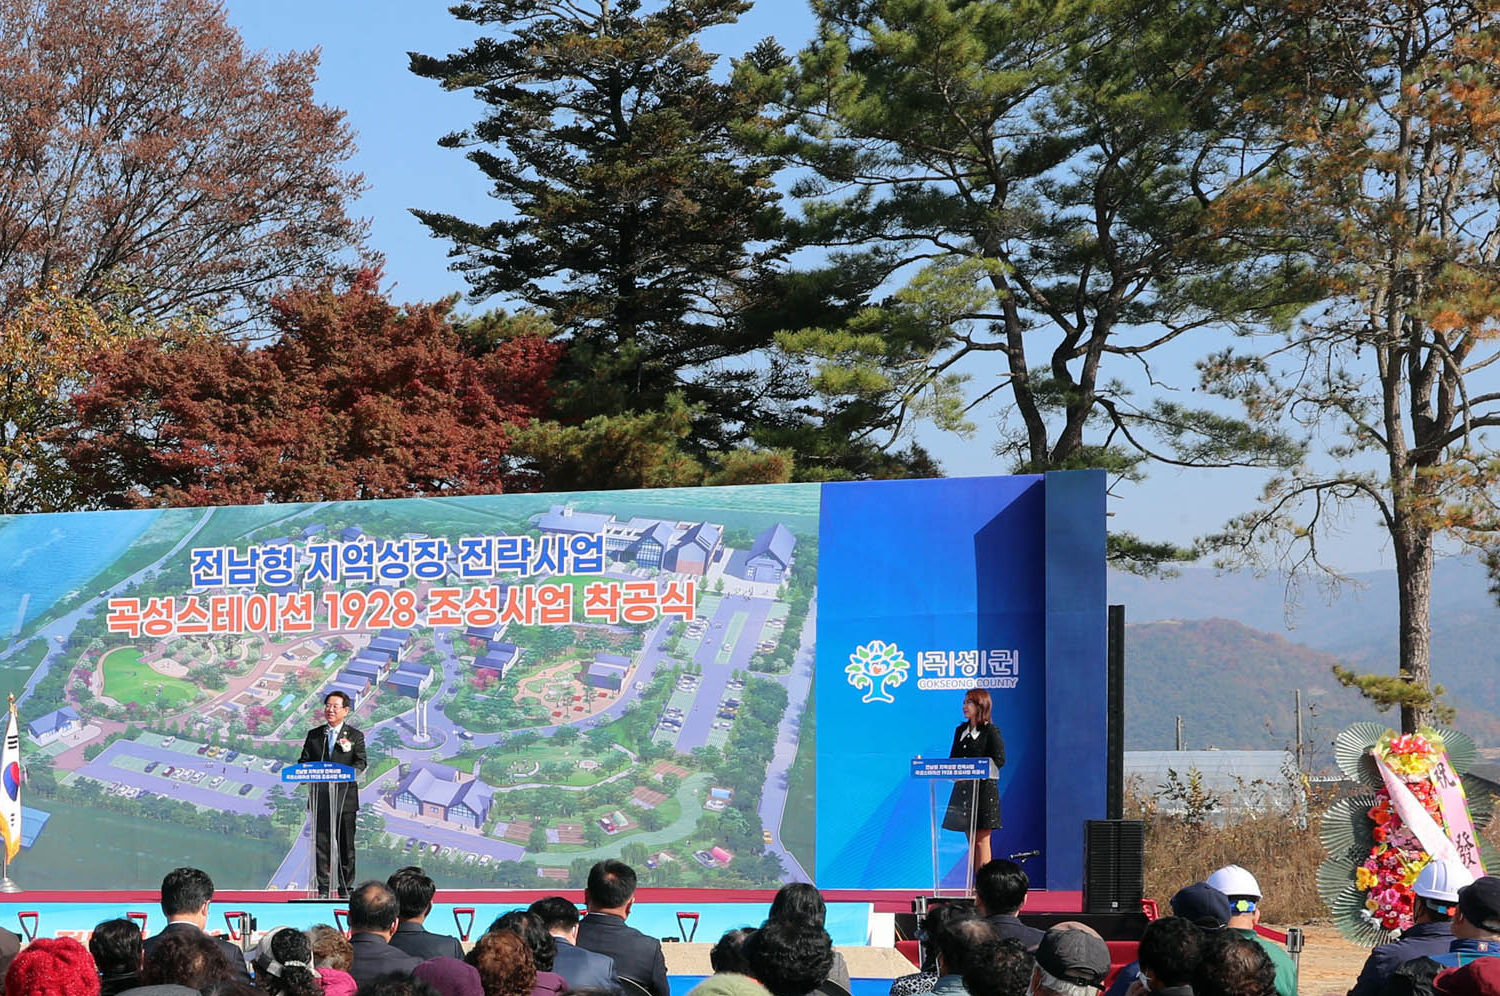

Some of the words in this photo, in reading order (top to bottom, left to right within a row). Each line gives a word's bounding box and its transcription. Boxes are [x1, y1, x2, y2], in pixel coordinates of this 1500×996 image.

[191, 548, 294, 587] 전남형
[306, 540, 448, 582] 지역성장
[460, 534, 603, 578] 전략사업
[106, 591, 314, 637] 곡성스테이션
[323, 590, 417, 632] 1928
[427, 583, 573, 627] 조성사업
[585, 580, 699, 623] 착공식
[918, 678, 974, 690] GOKSEONG
[976, 677, 1018, 689] COUNTY
